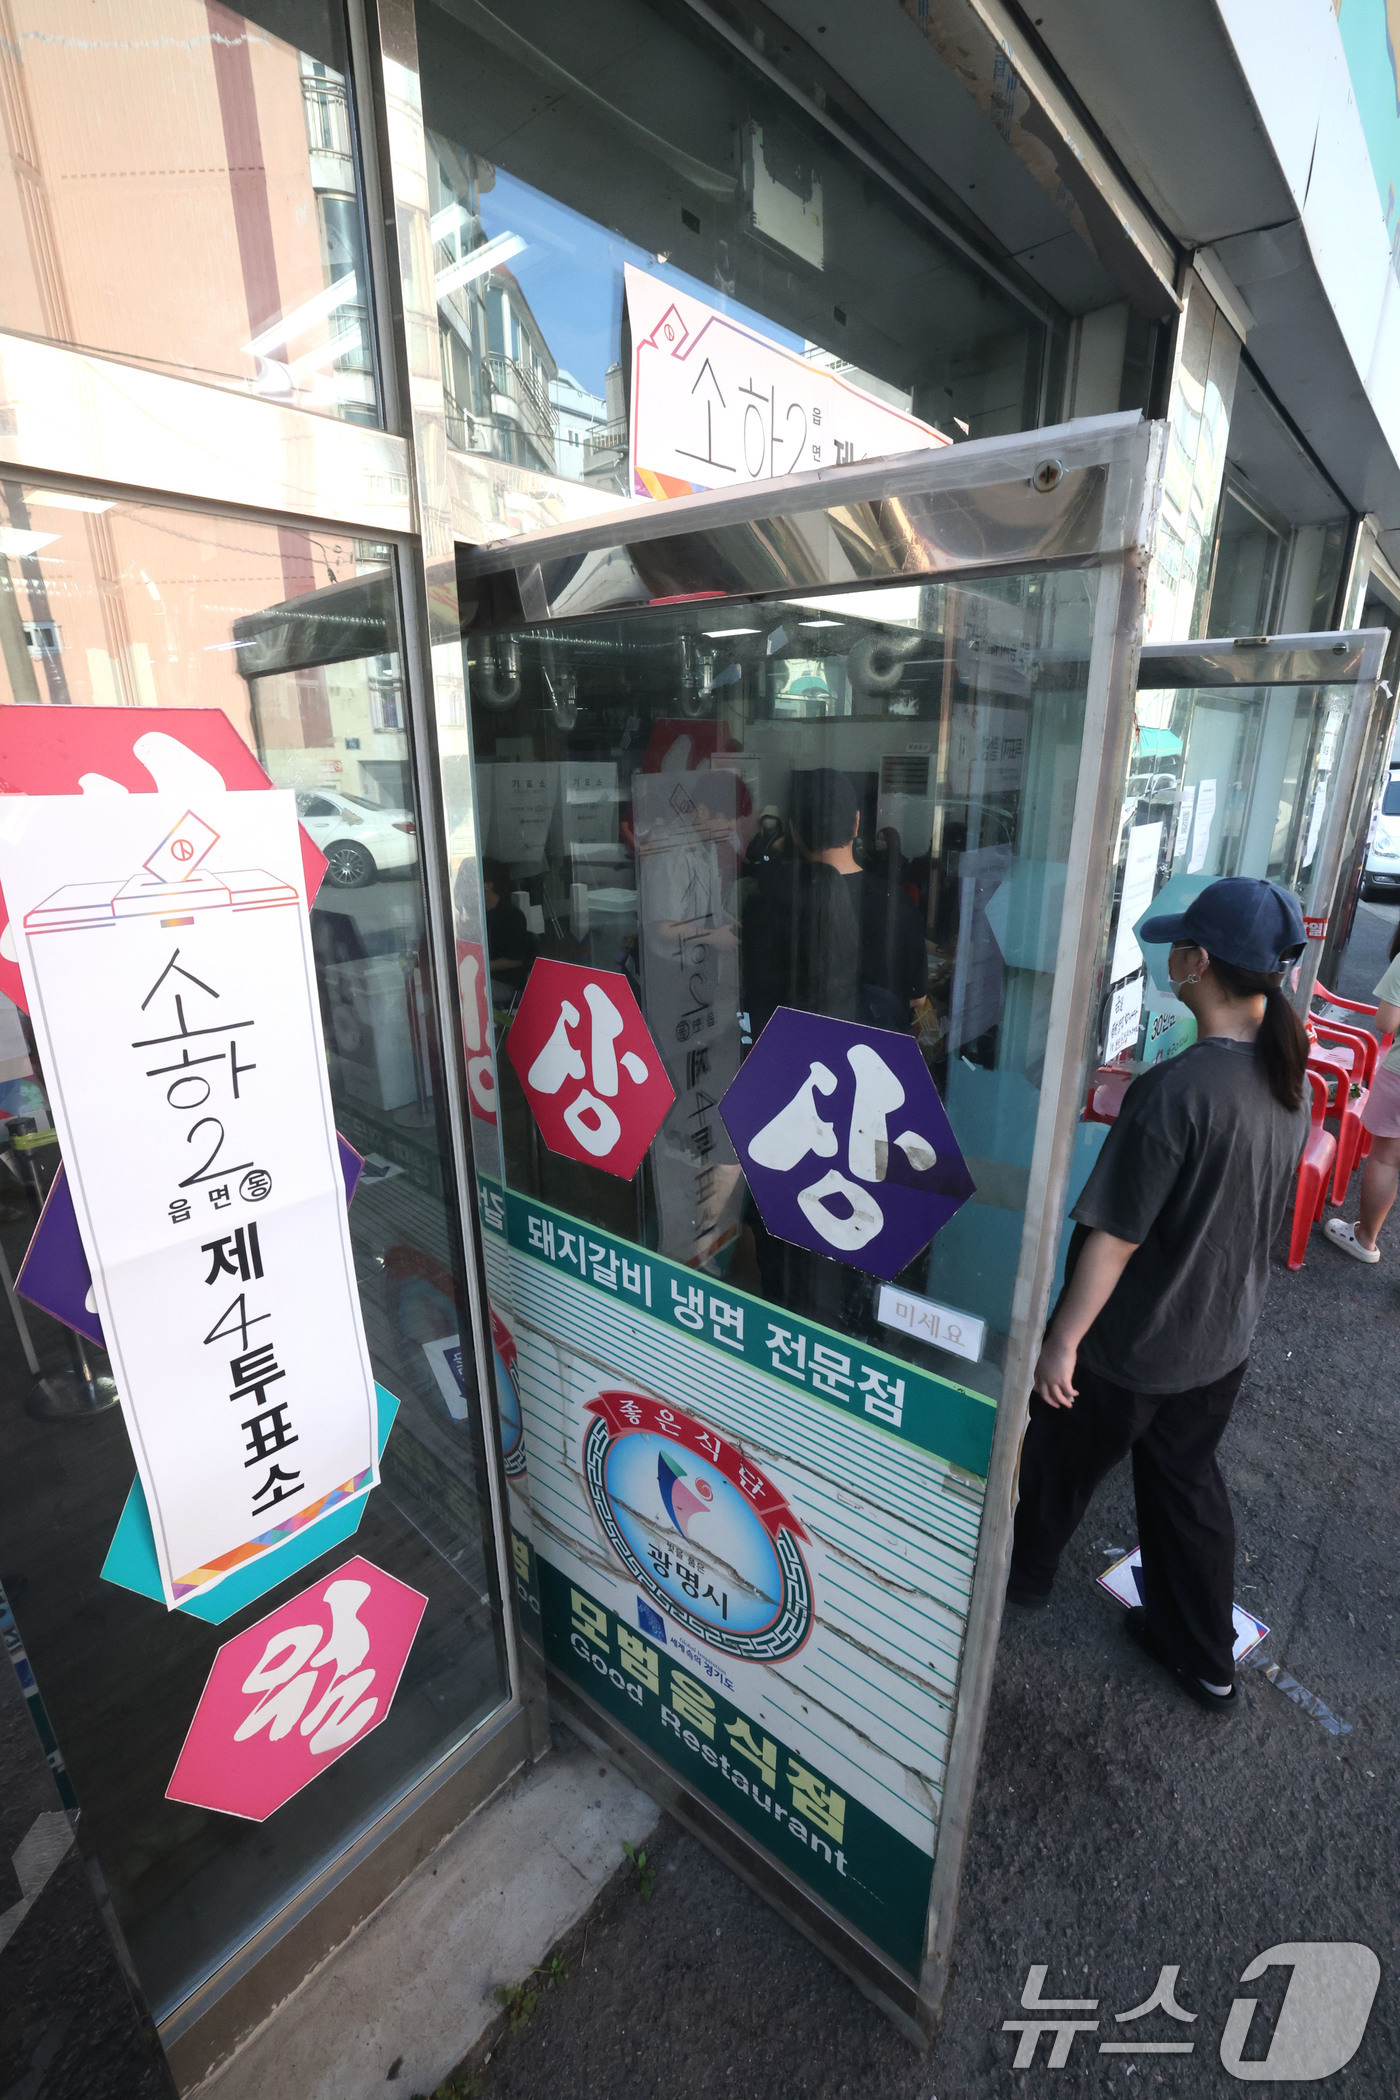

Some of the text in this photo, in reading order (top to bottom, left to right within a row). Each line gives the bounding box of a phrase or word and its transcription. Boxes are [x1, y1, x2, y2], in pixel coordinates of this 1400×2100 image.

[527, 1214, 907, 1430] 돼지갈비 냉면 전문점
[896, 1302, 966, 1347] 미세요
[647, 1543, 728, 1621] 광명시
[570, 1587, 847, 1846] 모범음식점
[704, 1661, 735, 1692] 경기도
[570, 1632, 848, 1877] Good Restaurant
